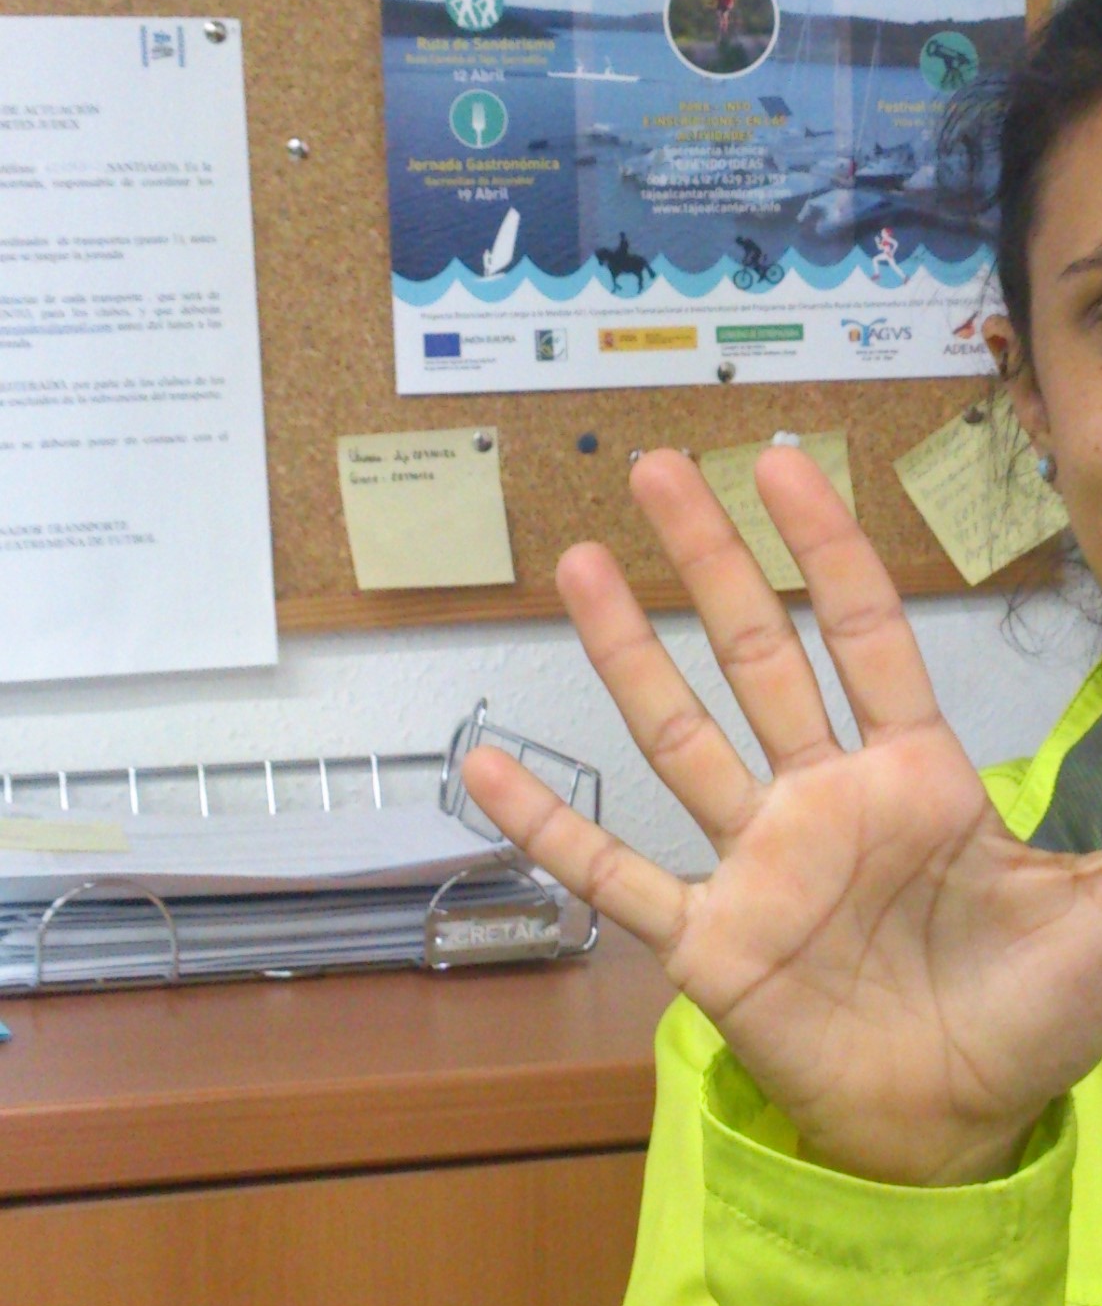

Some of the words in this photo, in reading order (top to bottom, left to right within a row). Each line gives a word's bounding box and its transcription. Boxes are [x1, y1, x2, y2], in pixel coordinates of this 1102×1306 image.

[471, 68, 506, 83] Abril
[406, 157, 463, 172] Jornada
[466, 156, 560, 172] Gastronómica
[475, 187, 509, 201] Abril
